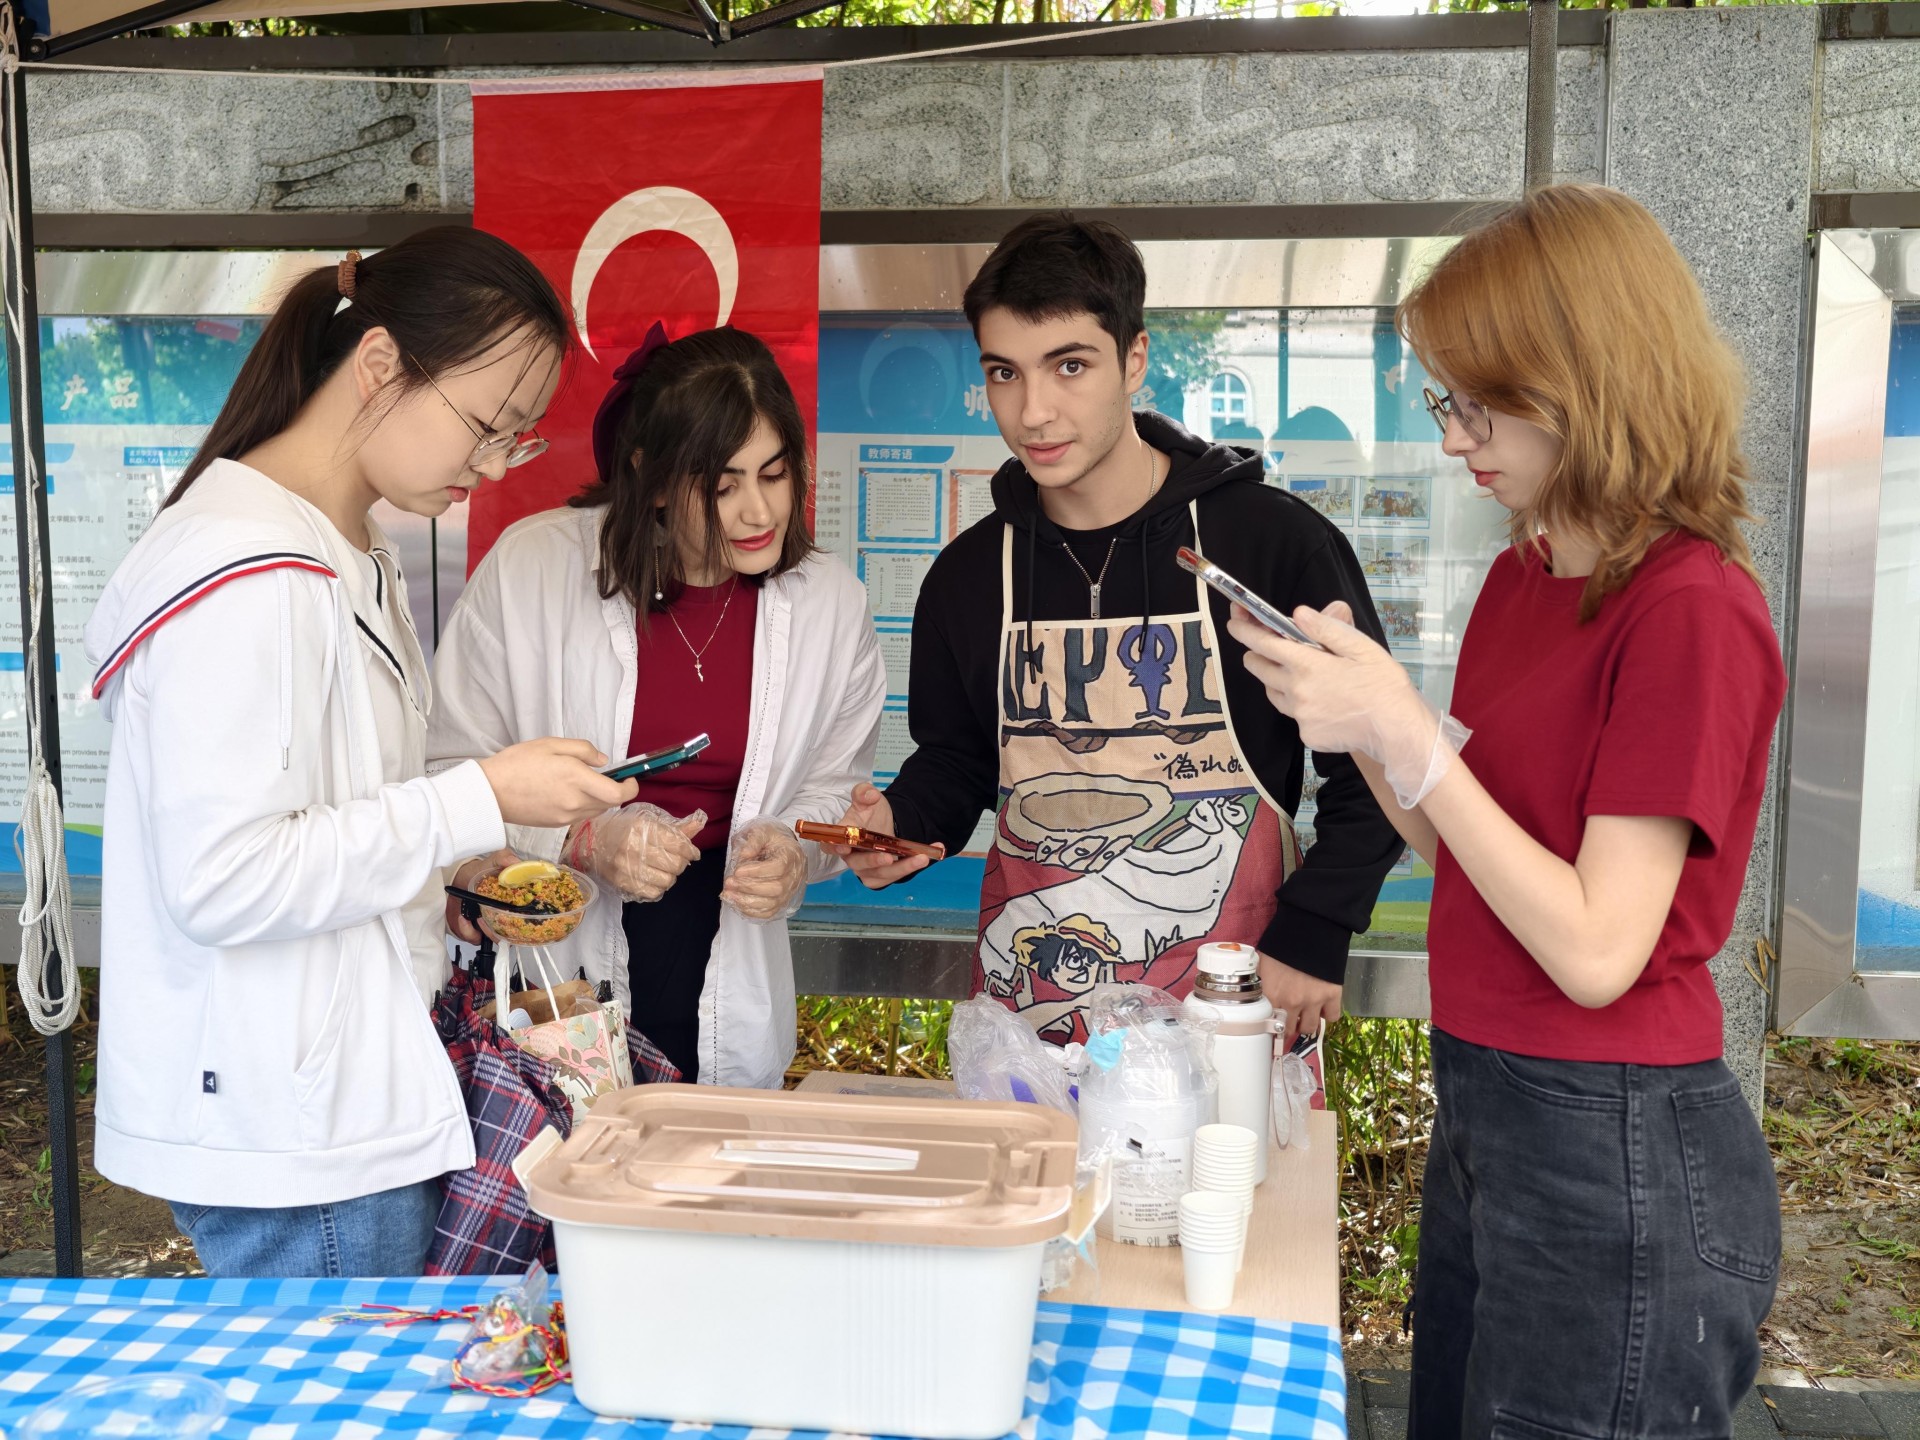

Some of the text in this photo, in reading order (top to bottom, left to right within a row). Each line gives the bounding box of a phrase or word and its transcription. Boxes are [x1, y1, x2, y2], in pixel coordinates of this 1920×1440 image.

[60, 374, 139, 411] 产品
[868, 447, 913, 460] 教师寄语
